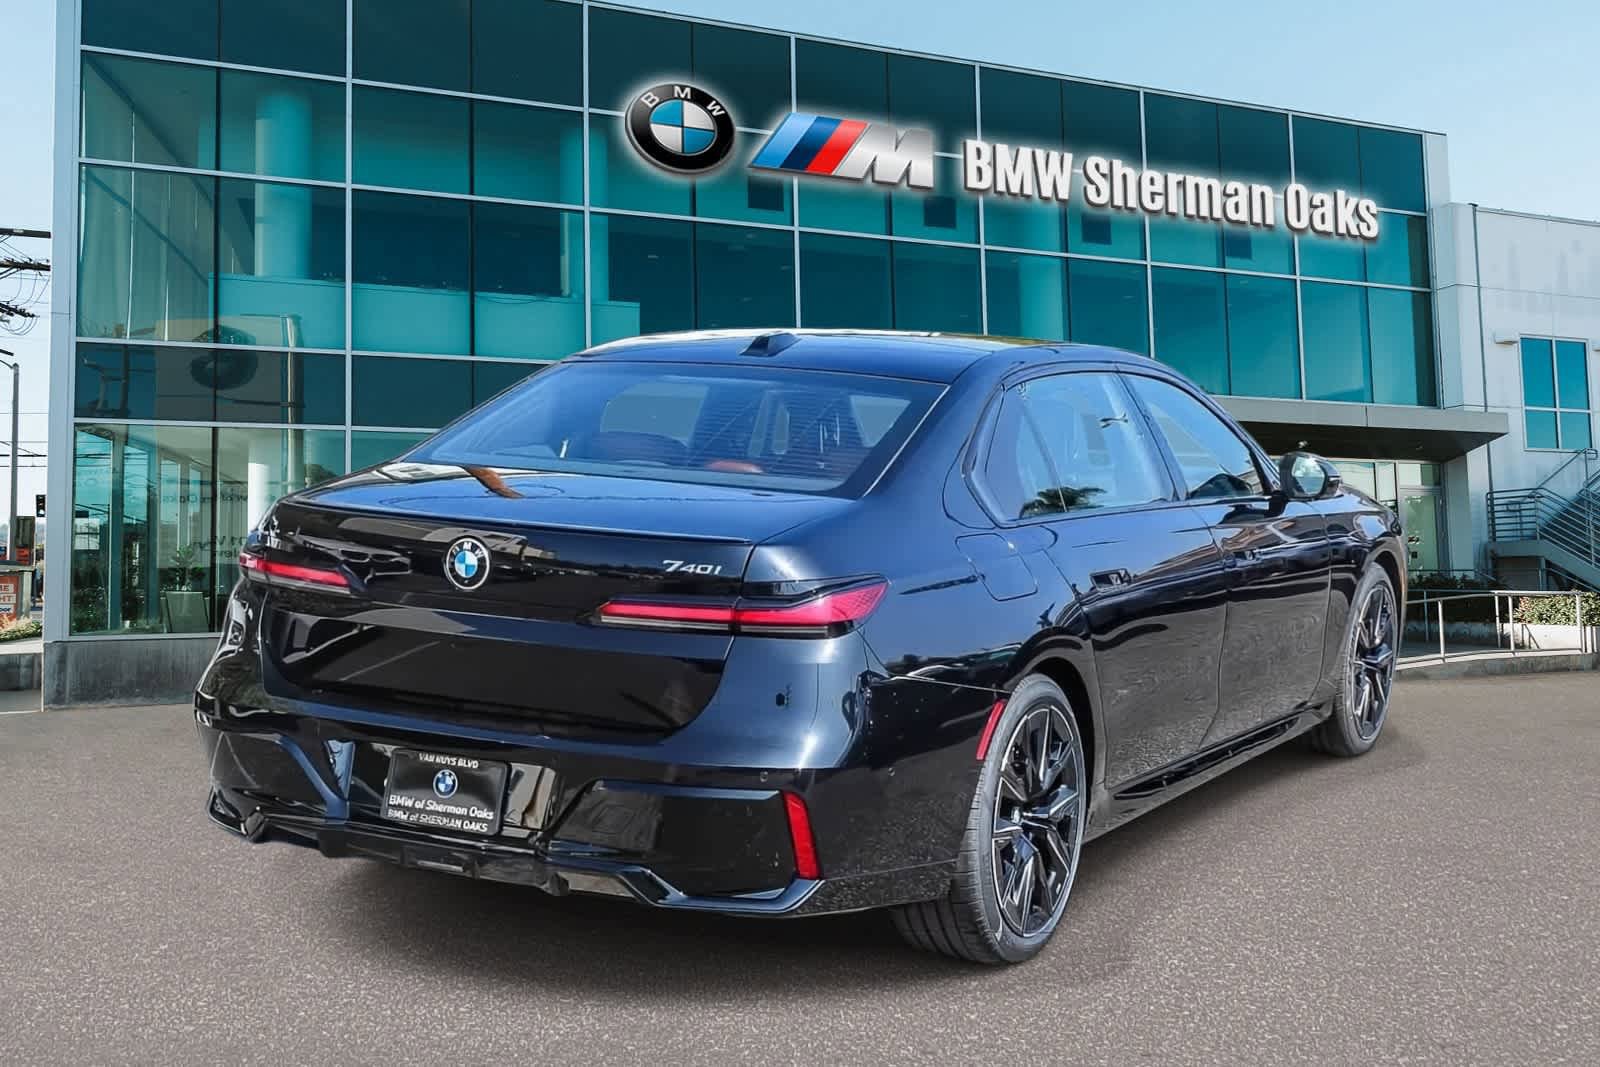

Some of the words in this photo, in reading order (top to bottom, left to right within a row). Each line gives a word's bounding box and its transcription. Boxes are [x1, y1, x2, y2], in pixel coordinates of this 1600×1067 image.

[641, 85, 725, 117] BMW
[963, 139, 1073, 203] BMW
[1083, 155, 1275, 227] Sherman
[1284, 183, 1379, 240] Oaks
[451, 541, 486, 559] BMW
[419, 753, 435, 763] VAN
[457, 758, 479, 769] BLVD
[388, 794, 415, 808] BMW
[414, 799, 424, 809] of
[425, 800, 467, 816] Sherman
[469, 806, 494, 820] Oaks
[387, 808, 409, 821] BMW
[409, 812, 419, 822] of
[463, 820, 488, 833] OAKS
